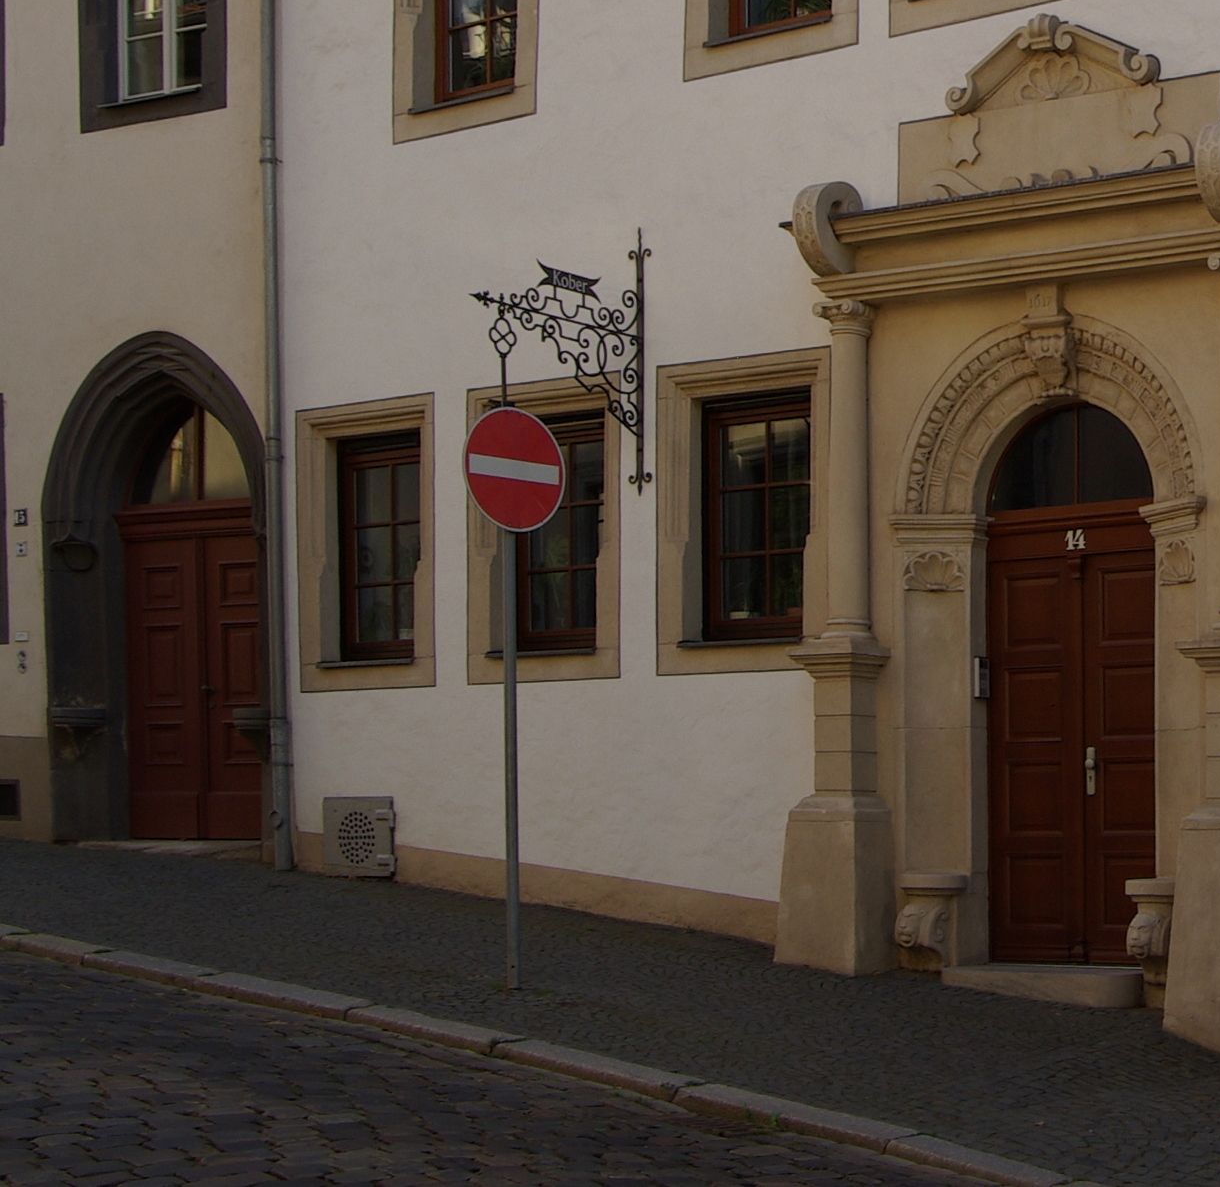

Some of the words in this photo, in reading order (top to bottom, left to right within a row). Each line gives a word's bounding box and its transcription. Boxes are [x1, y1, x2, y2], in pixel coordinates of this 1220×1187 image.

[552, 269, 588, 293] Kober
[1028, 293, 1052, 309] 1617
[14, 510, 26, 524] 15
[1064, 528, 1087, 551] 14
